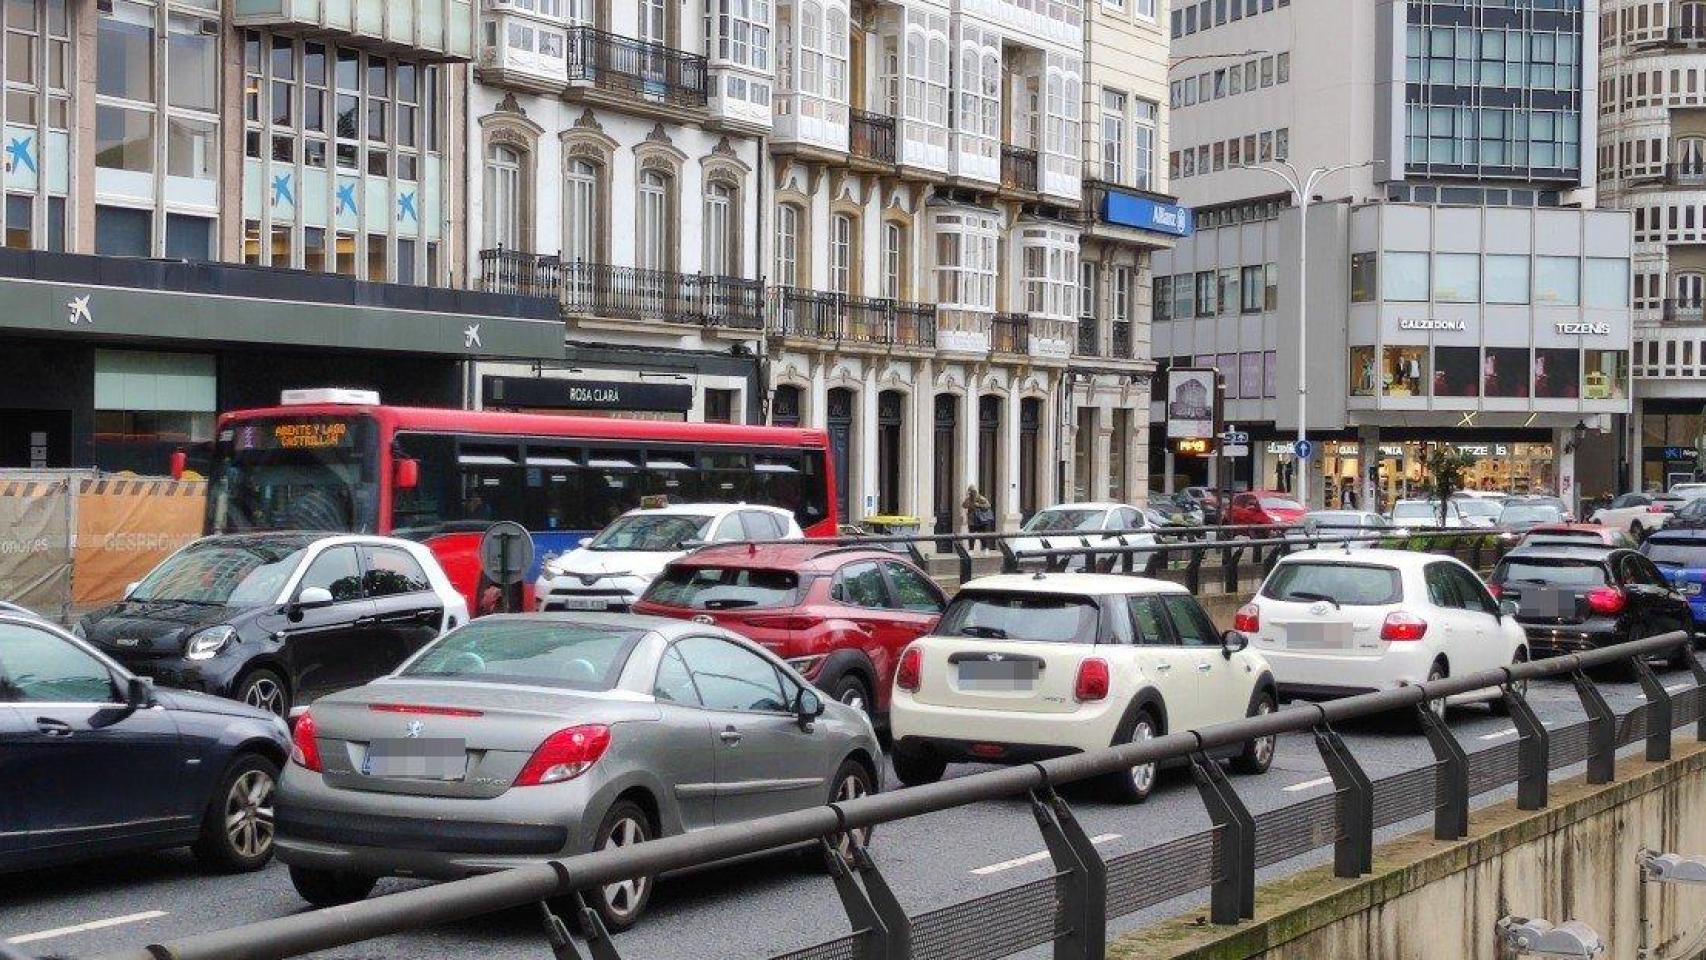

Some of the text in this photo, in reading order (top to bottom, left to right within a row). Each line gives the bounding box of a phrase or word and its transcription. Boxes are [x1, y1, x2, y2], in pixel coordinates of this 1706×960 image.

[1399, 319, 1466, 331] CALZEDONIA
[1555, 322, 1610, 335] TEZENIS
[569, 387, 592, 401] ROSA
